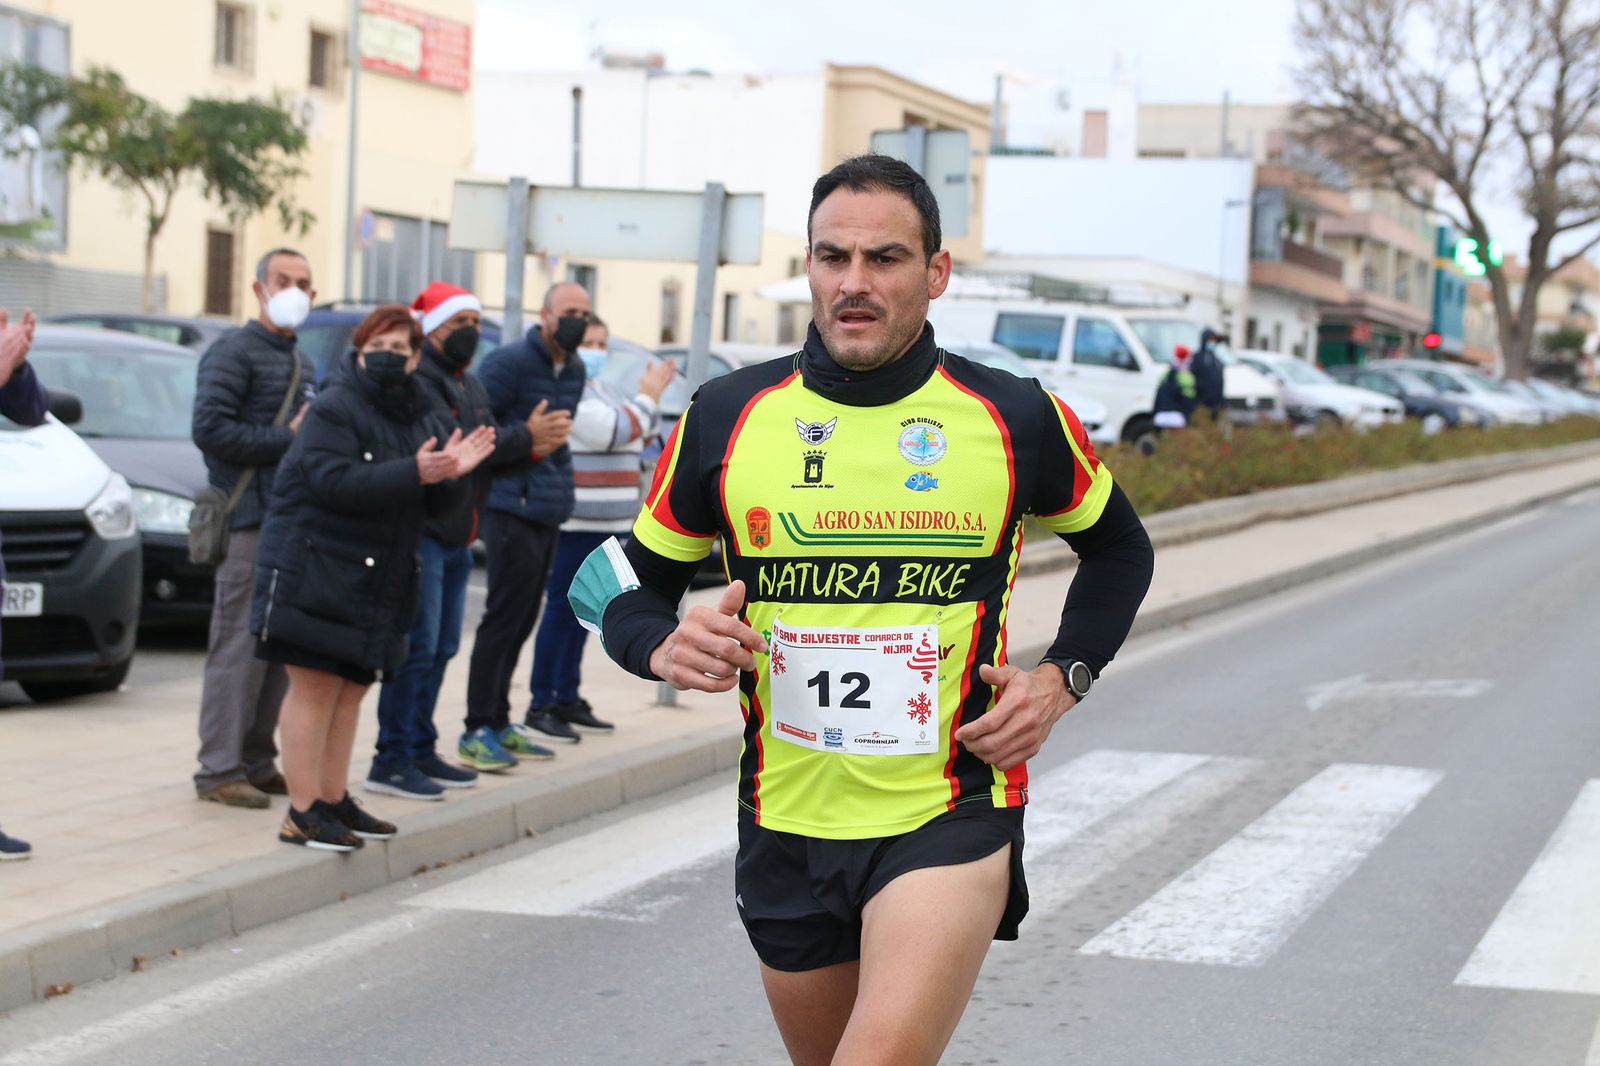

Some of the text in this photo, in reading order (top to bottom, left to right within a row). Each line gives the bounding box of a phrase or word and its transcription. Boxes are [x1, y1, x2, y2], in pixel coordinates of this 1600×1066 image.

[900, 417, 944, 430] CLUB CICLISTA
[812, 510, 987, 533] AGRO SAN ISIDRO, S.A.
[758, 561, 971, 599] NATURA BIKE
[779, 628, 797, 643] SAN
[800, 633, 861, 645] SILVESTRE
[864, 633, 902, 642] COMARCA
[903, 632, 914, 641] DE
[807, 670, 871, 709] 12
